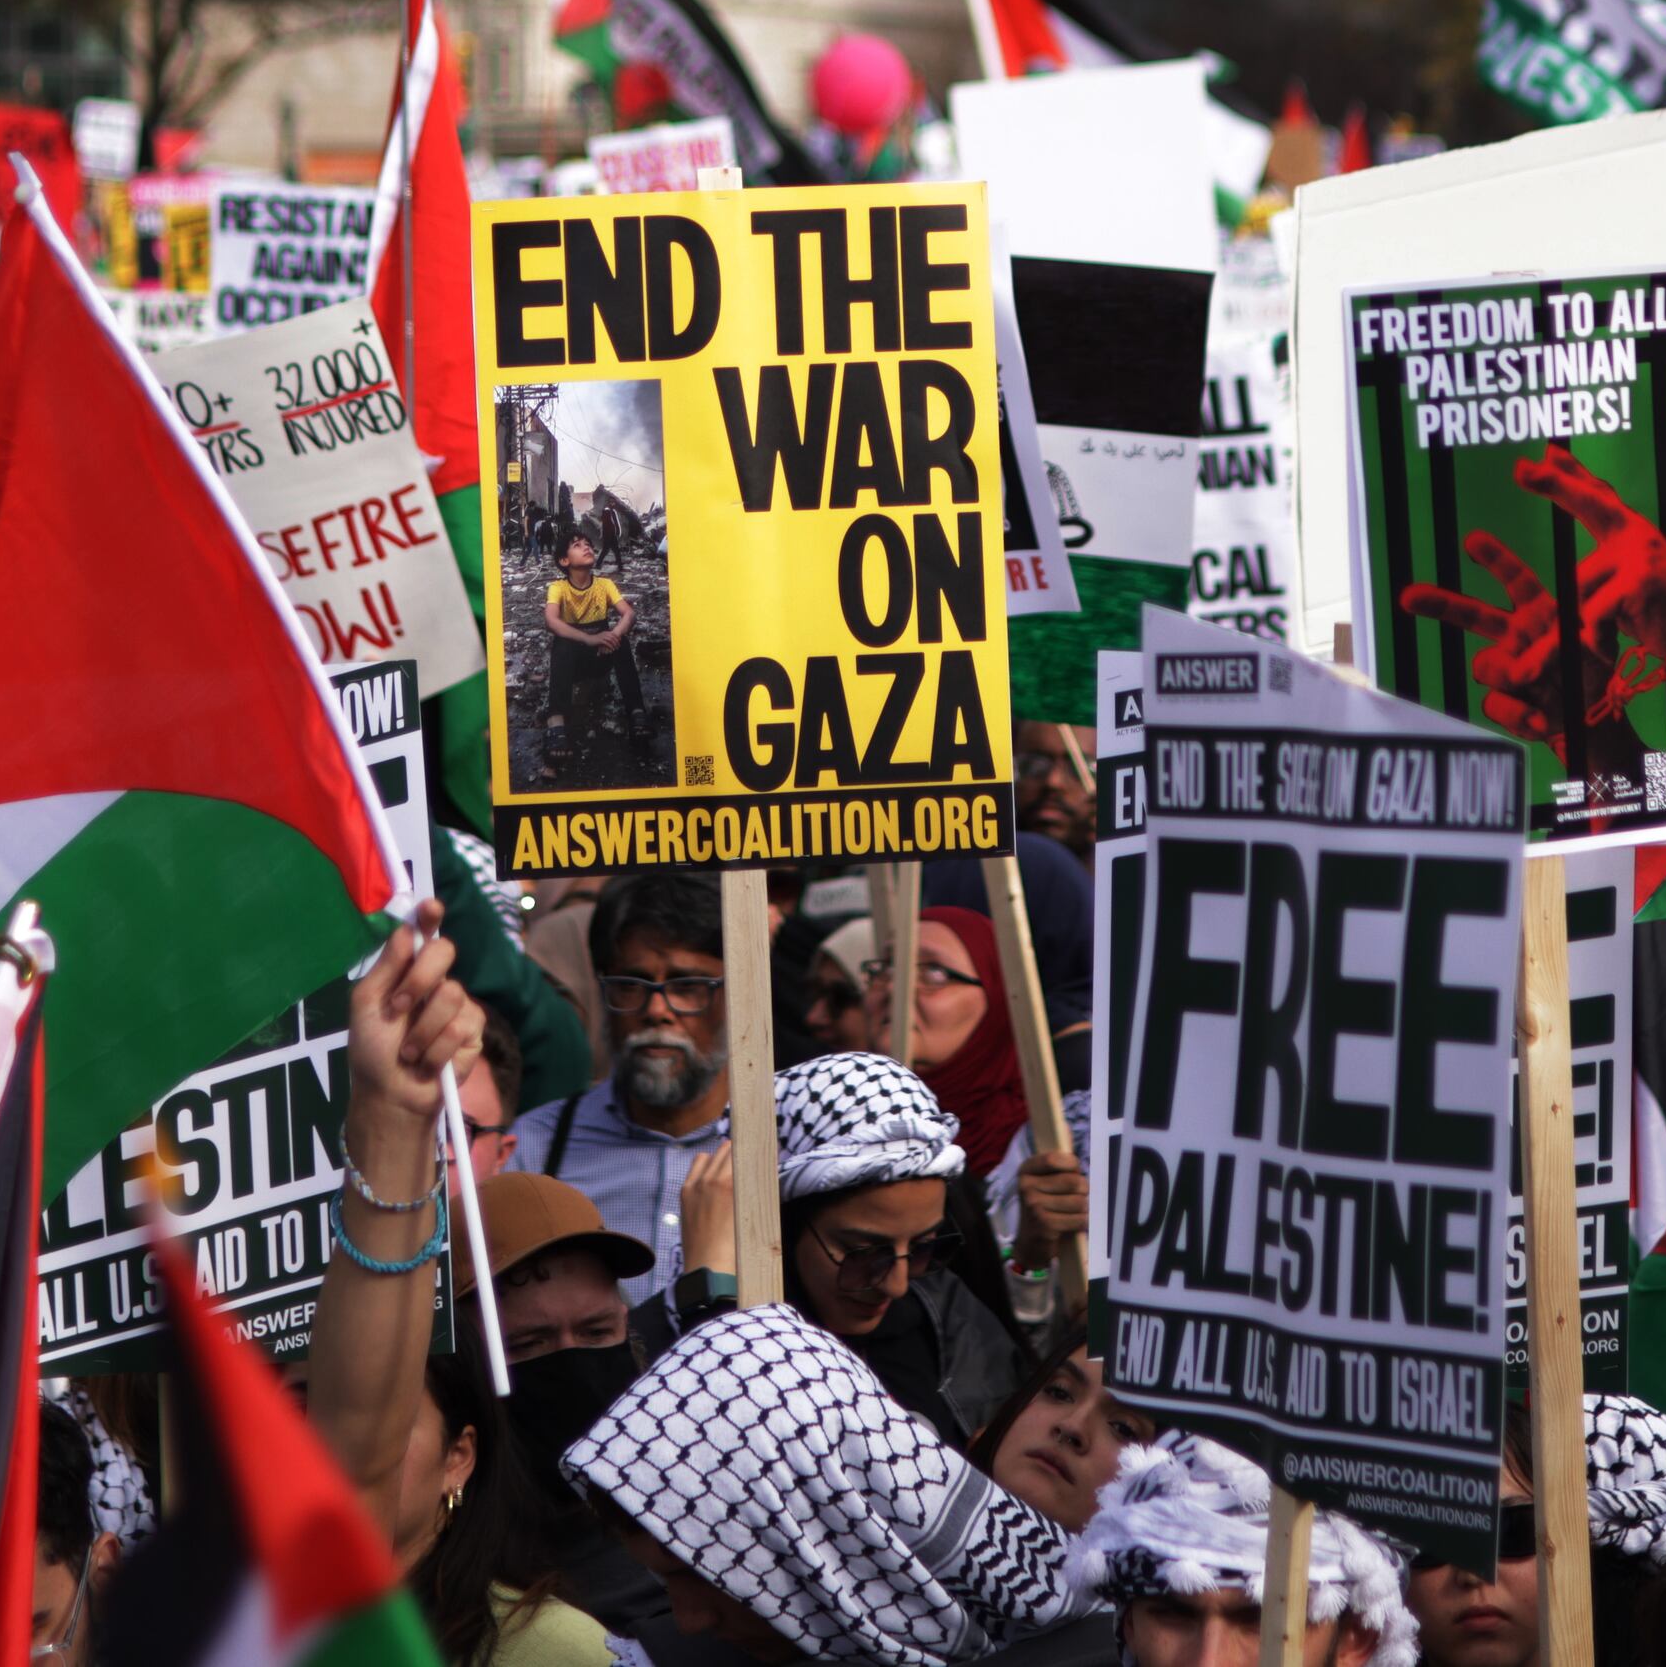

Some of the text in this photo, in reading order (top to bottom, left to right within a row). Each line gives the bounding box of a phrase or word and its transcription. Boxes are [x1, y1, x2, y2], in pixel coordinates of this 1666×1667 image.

[491, 205, 973, 368] END THE
[1360, 297, 1535, 354] FREEDOM
[1548, 292, 1595, 338] TO
[1406, 338, 1637, 400] PALESTINIAN
[283, 389, 407, 456] INJURED
[714, 360, 980, 513] WAR
[1416, 387, 1632, 449] PRISONERS!
[838, 513, 987, 648] ON
[723, 650, 997, 793] GAZA
[1161, 666, 1254, 690] ANSWER
[1157, 740, 1515, 827] END THE ON GAZA NOW!
[512, 794, 999, 872] ANSWERCOALITION.ORG
[1135, 837, 1511, 1172] FREE
[36, 1208, 306, 1344] ALL AID TO
[1119, 1145, 1493, 1335] PALESTINE!
[1114, 1311, 1493, 1442] END ALL U.S. AID TO ISRAEL
[1284, 1452, 1493, 1505] @ANSWERCOALITION
[1346, 1493, 1491, 1531] ANSWERCOALITION.ORG
